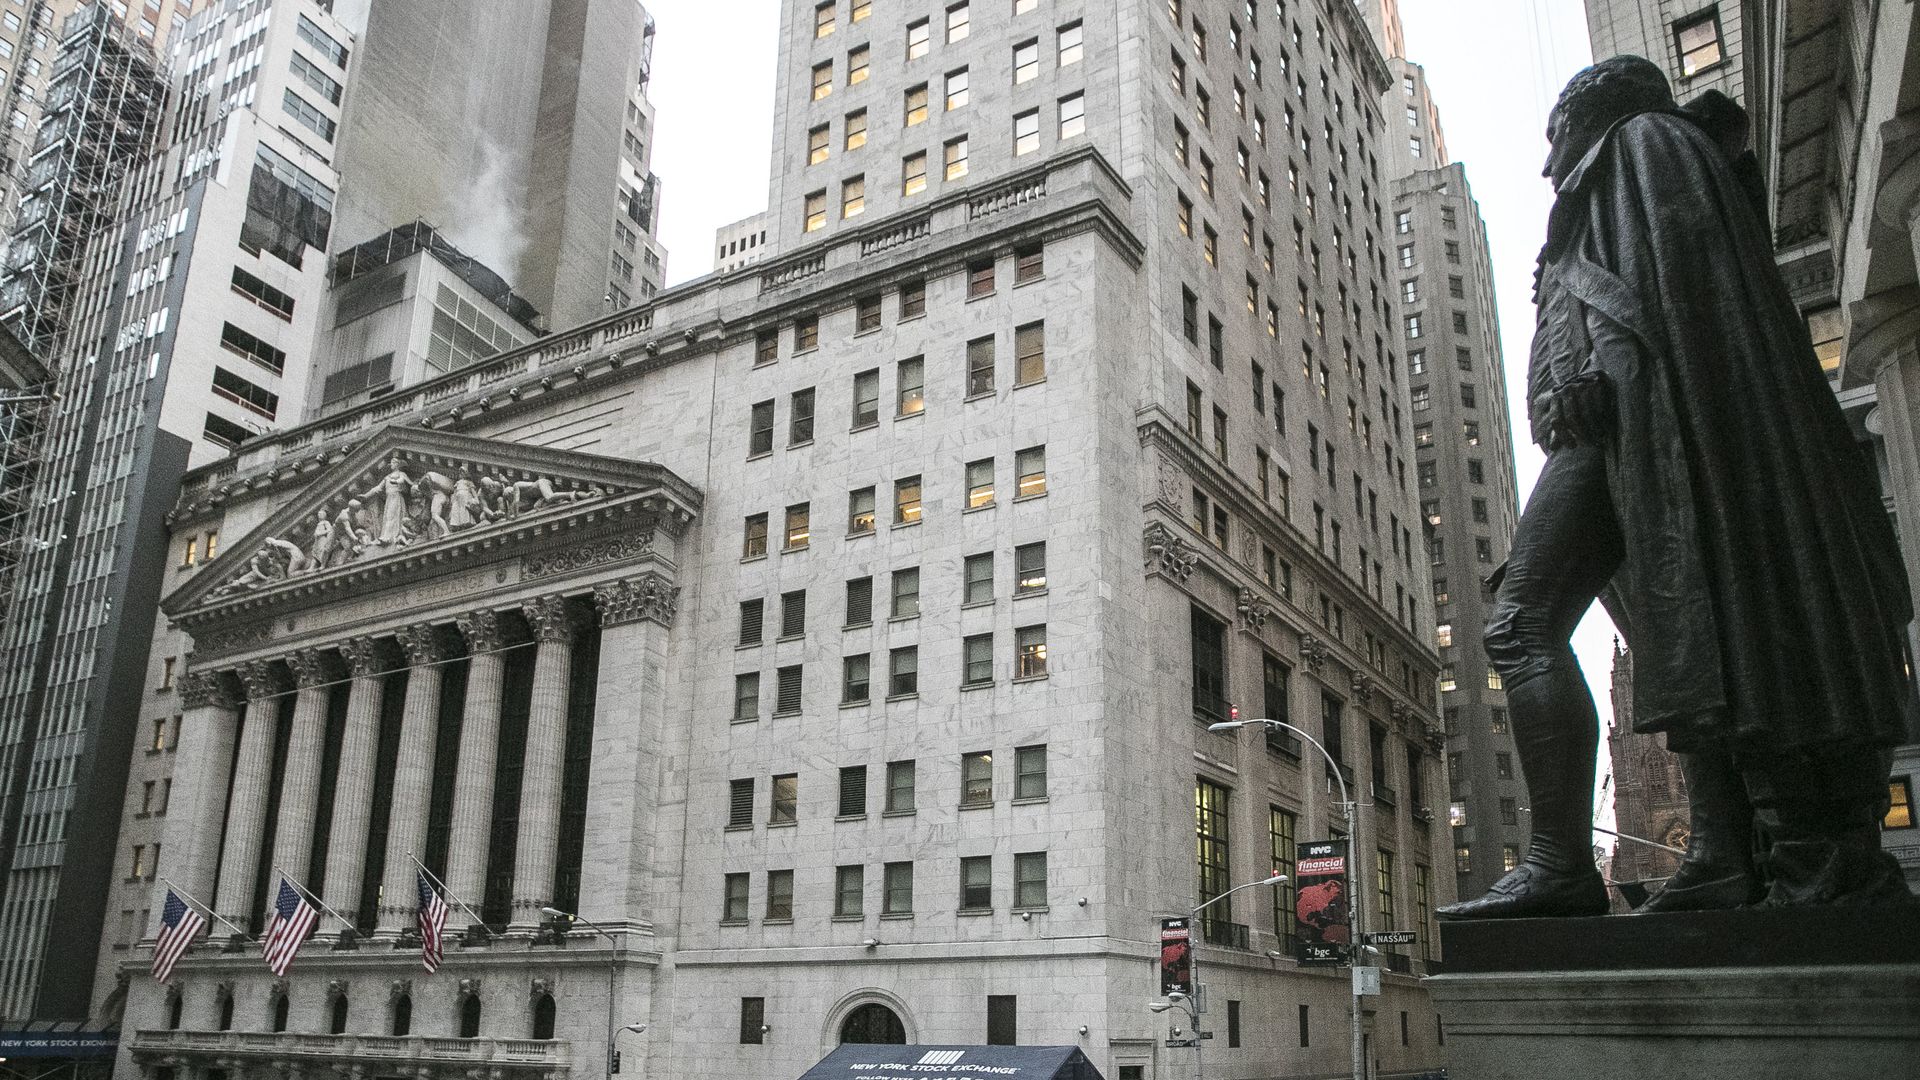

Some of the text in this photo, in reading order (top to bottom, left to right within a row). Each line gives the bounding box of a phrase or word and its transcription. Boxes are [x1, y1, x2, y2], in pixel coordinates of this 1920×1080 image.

[1310, 845, 1331, 855] NYC
[1298, 858, 1343, 871] financial
[1377, 934, 1408, 943] NASSAU
[1314, 947, 1330, 958] bgc
[878, 1063, 911, 1071] YORK
[910, 1064, 951, 1072] STOCK
[950, 1064, 1018, 1075] EXCHANGE
